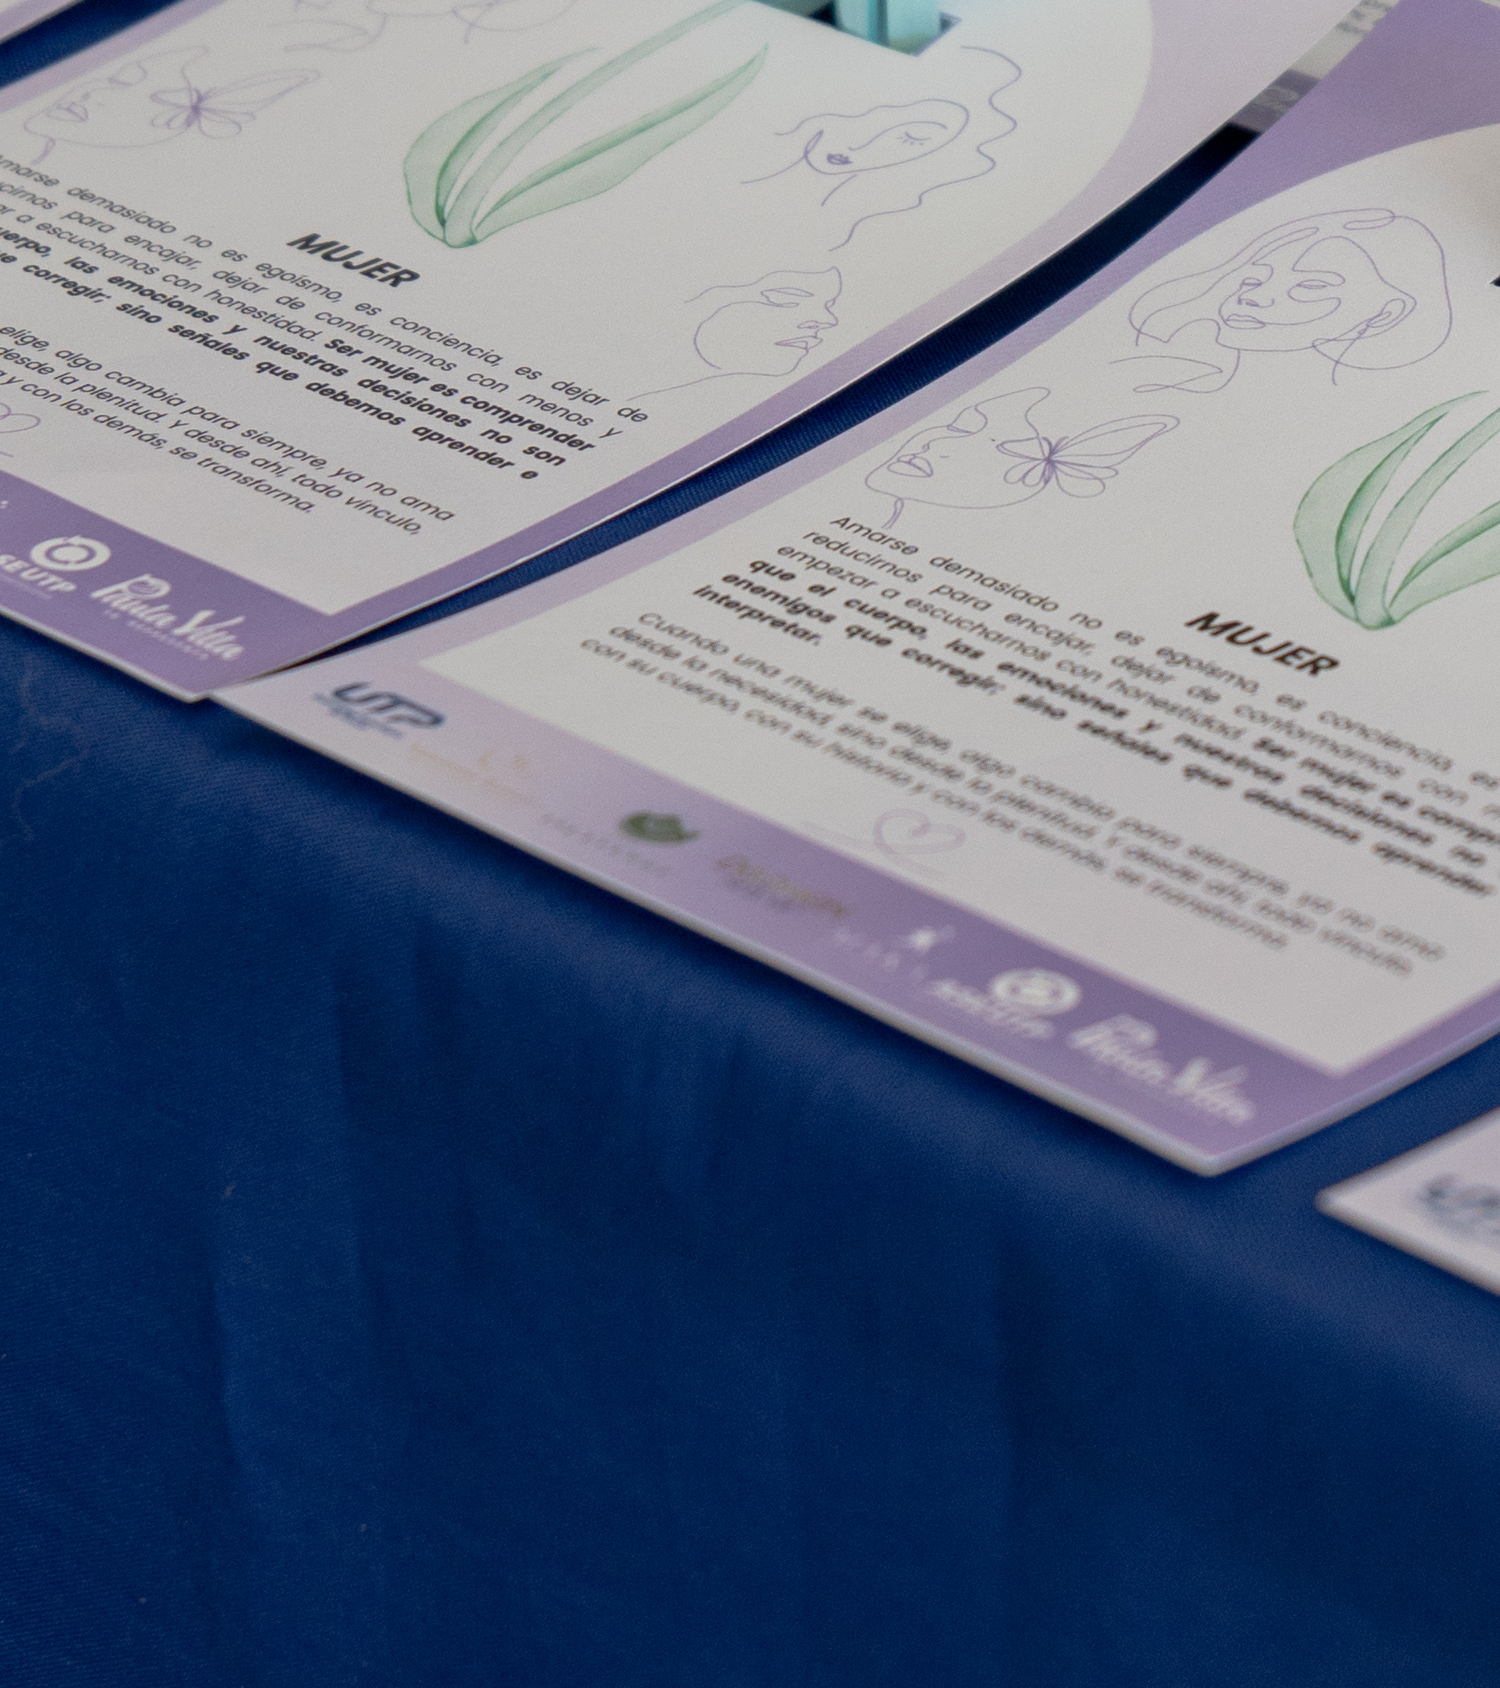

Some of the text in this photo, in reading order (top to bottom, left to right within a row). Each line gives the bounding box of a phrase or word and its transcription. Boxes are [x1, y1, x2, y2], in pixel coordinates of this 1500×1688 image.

[15, 214, 36, 224] a
[35, 222, 160, 275] escucharnos
[161, 273, 203, 293] con
[203, 289, 322, 342] honestidad.
[323, 338, 364, 357] Ser
[361, 355, 430, 384] mujer
[429, 383, 460, 398] es
[460, 395, 595, 451] comprender
[59, 210, 117, 234] para
[123, 234, 202, 271] encajar,
[211, 270, 269, 294] dejar
[274, 295, 307, 311] de
[314, 311, 457, 372] conformarnos
[465, 372, 510, 394] con
[517, 393, 594, 427] menos
[597, 427, 624, 439] y
[66, 187, 177, 234] demasiado
[182, 234, 214, 249] no
[219, 249, 249, 263] es
[254, 262, 343, 303] egoísmo,
[353, 302, 383, 317] es
[389, 316, 503, 367] conciencia,
[513, 366, 544, 381] es
[550, 380, 610, 406] dejar
[616, 407, 649, 423] de
[286, 232, 421, 288] MUJER
[22, 264, 112, 303] corregir;
[115, 303, 163, 324] sino
[167, 324, 250, 361] señales
[255, 361, 300, 382] que
[305, 382, 406, 426] debemos
[411, 426, 515, 469] aprender
[519, 470, 540, 480] e
[54, 349, 103, 372] algo
[104, 371, 186, 407] cambia
[179, 405, 241, 430] para
[240, 429, 328, 471] siempre,
[327, 467, 366, 484] ya
[364, 481, 398, 497] no
[399, 496, 456, 522] ama
[63, 256, 100, 275] las
[107, 275, 220, 324] emociones
[221, 324, 249, 336] y
[253, 335, 349, 377] nuestras
[357, 378, 472, 428] decisiones
[478, 428, 514, 445] no
[521, 445, 567, 467] son
[19, 383, 63, 403] con
[59, 398, 96, 417] los
[92, 414, 168, 450] demás,
[168, 446, 199, 461] se
[196, 457, 316, 514] transforma.
[52, 371, 80, 386] la
[71, 383, 168, 424] plenitud.
[167, 419, 190, 430] Y
[183, 428, 251, 459] desde
[249, 457, 294, 478] ahí,
[290, 473, 344, 499] todo
[344, 496, 422, 536] vínculo,
[90, 573, 173, 629] Paula
[173, 609, 246, 661] Villa
[693, 585, 822, 646] interpretar.
[749, 560, 986, 661] que el cuerpo, las
[829, 517, 1146, 647] Amarse demasiado no es
[1183, 611, 1340, 676] MUJER
